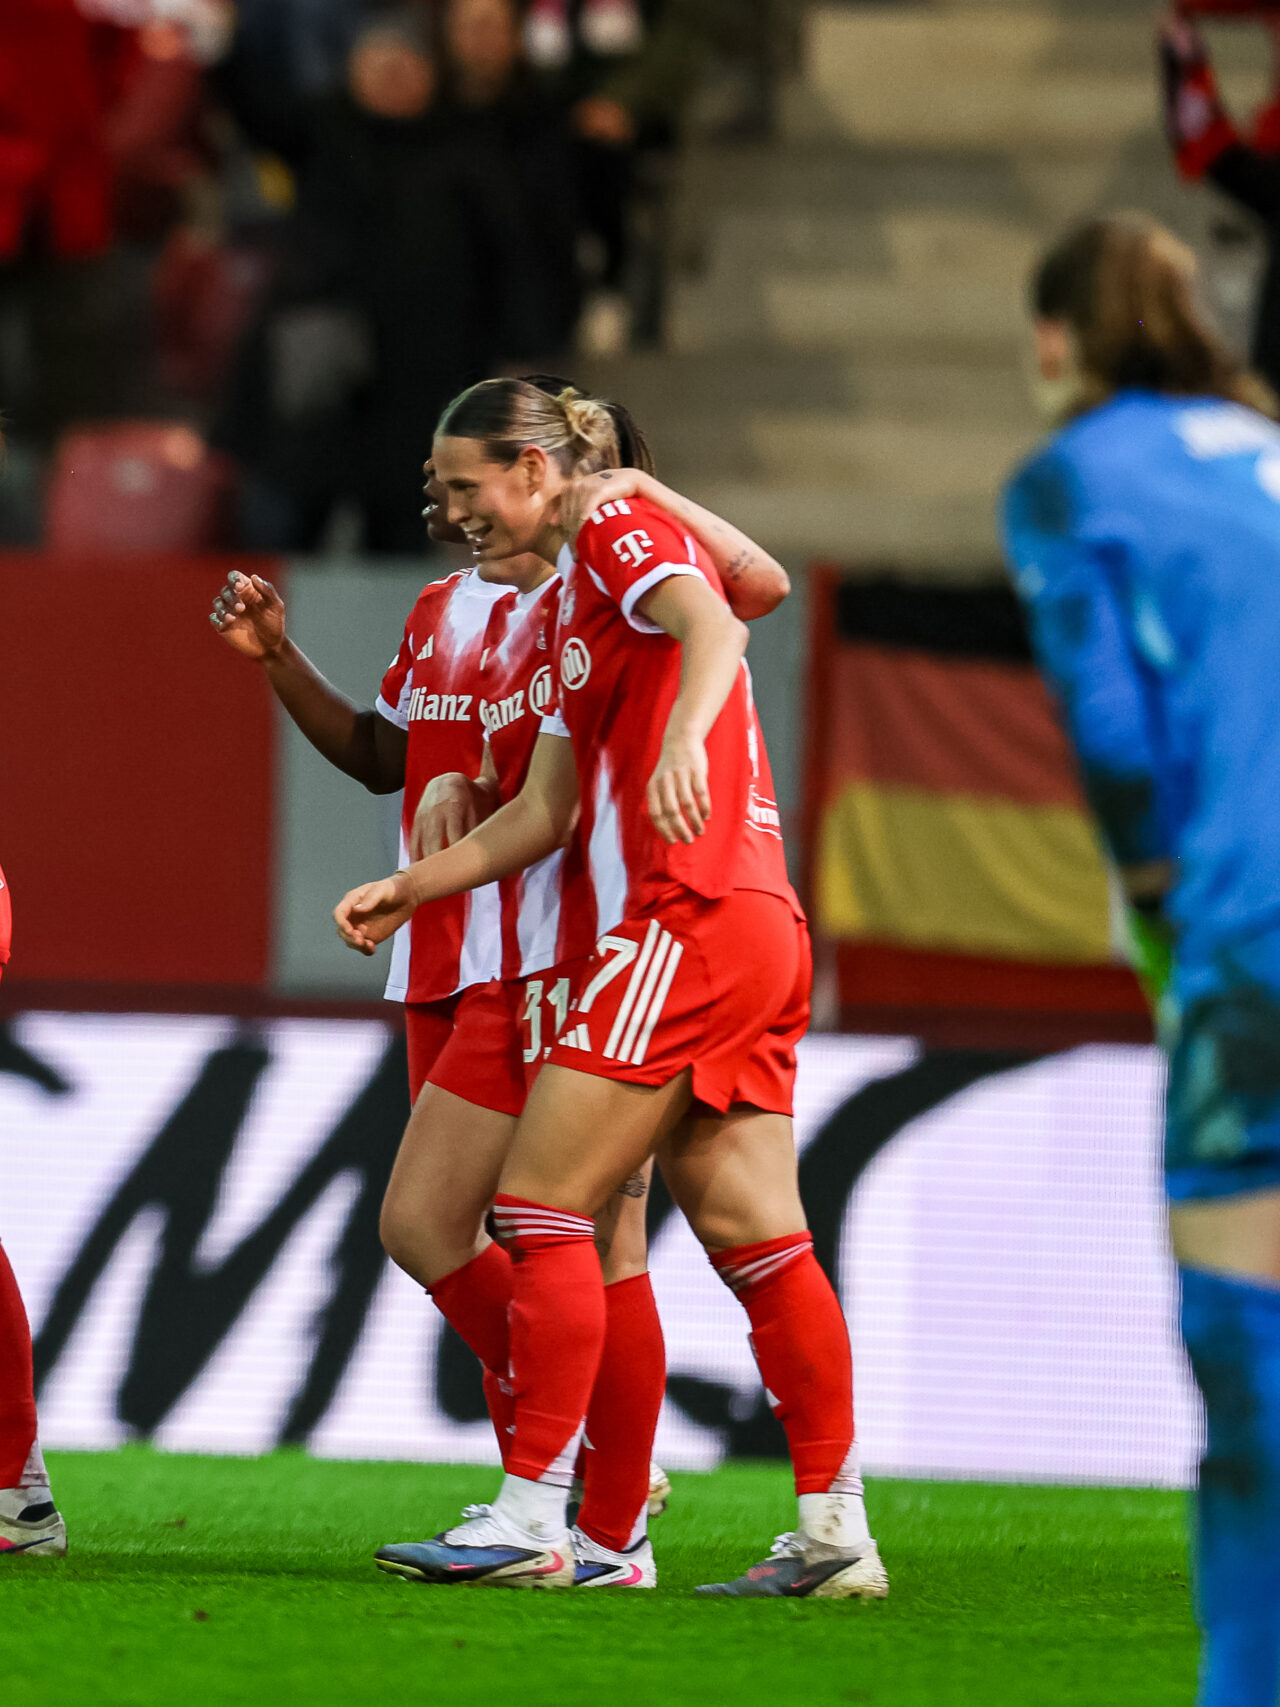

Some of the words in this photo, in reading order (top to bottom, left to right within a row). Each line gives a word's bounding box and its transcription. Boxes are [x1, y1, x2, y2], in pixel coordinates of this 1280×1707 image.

[611, 529, 654, 568] T
[407, 686, 473, 721] llianz
[568, 935, 639, 1013] 7
